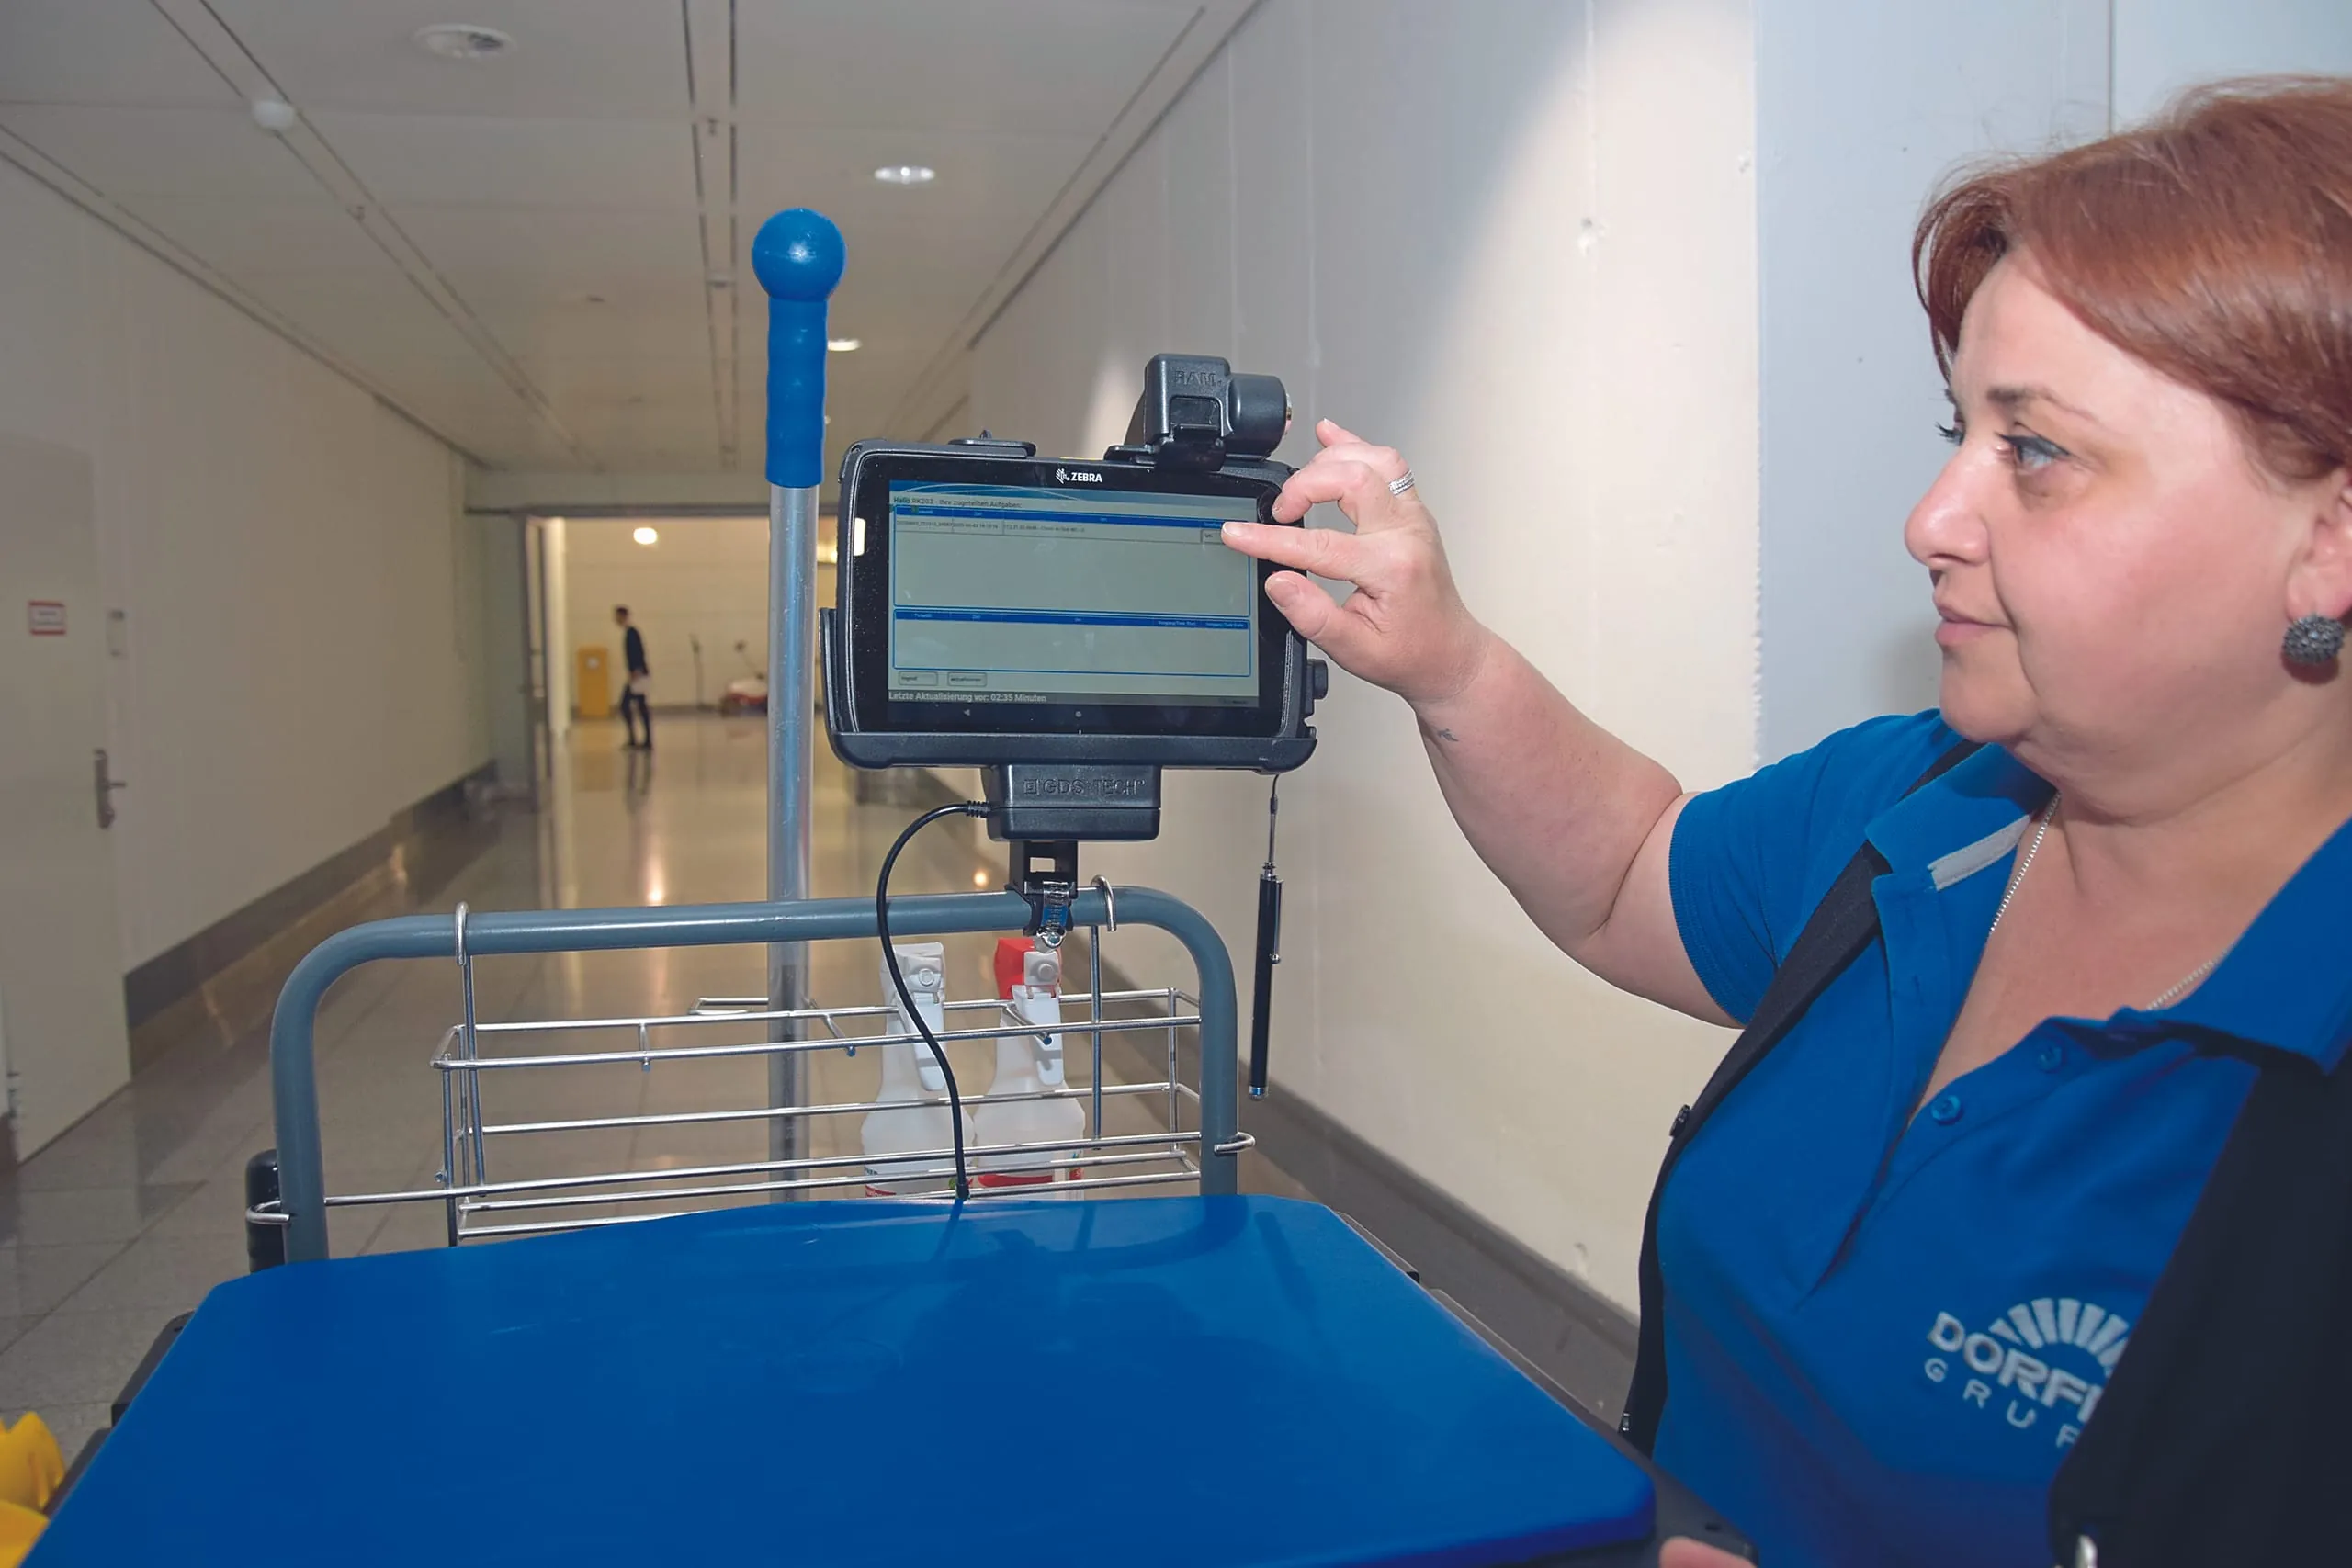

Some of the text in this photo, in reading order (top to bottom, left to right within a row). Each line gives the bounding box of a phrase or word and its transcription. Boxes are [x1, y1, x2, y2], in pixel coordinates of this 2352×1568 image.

[1174, 370, 1217, 387] RAM
[1070, 471, 1103, 483] ZEBRA
[893, 496, 910, 504] Hallo
[989, 501, 1023, 510] Aufgaben:
[888, 692, 914, 701] Letzte
[915, 693, 973, 703] Aktualisierung
[990, 694, 1013, 702] 02:35
[1014, 694, 1047, 703] Minuten
[1043, 778, 1138, 795] GDS TECH
